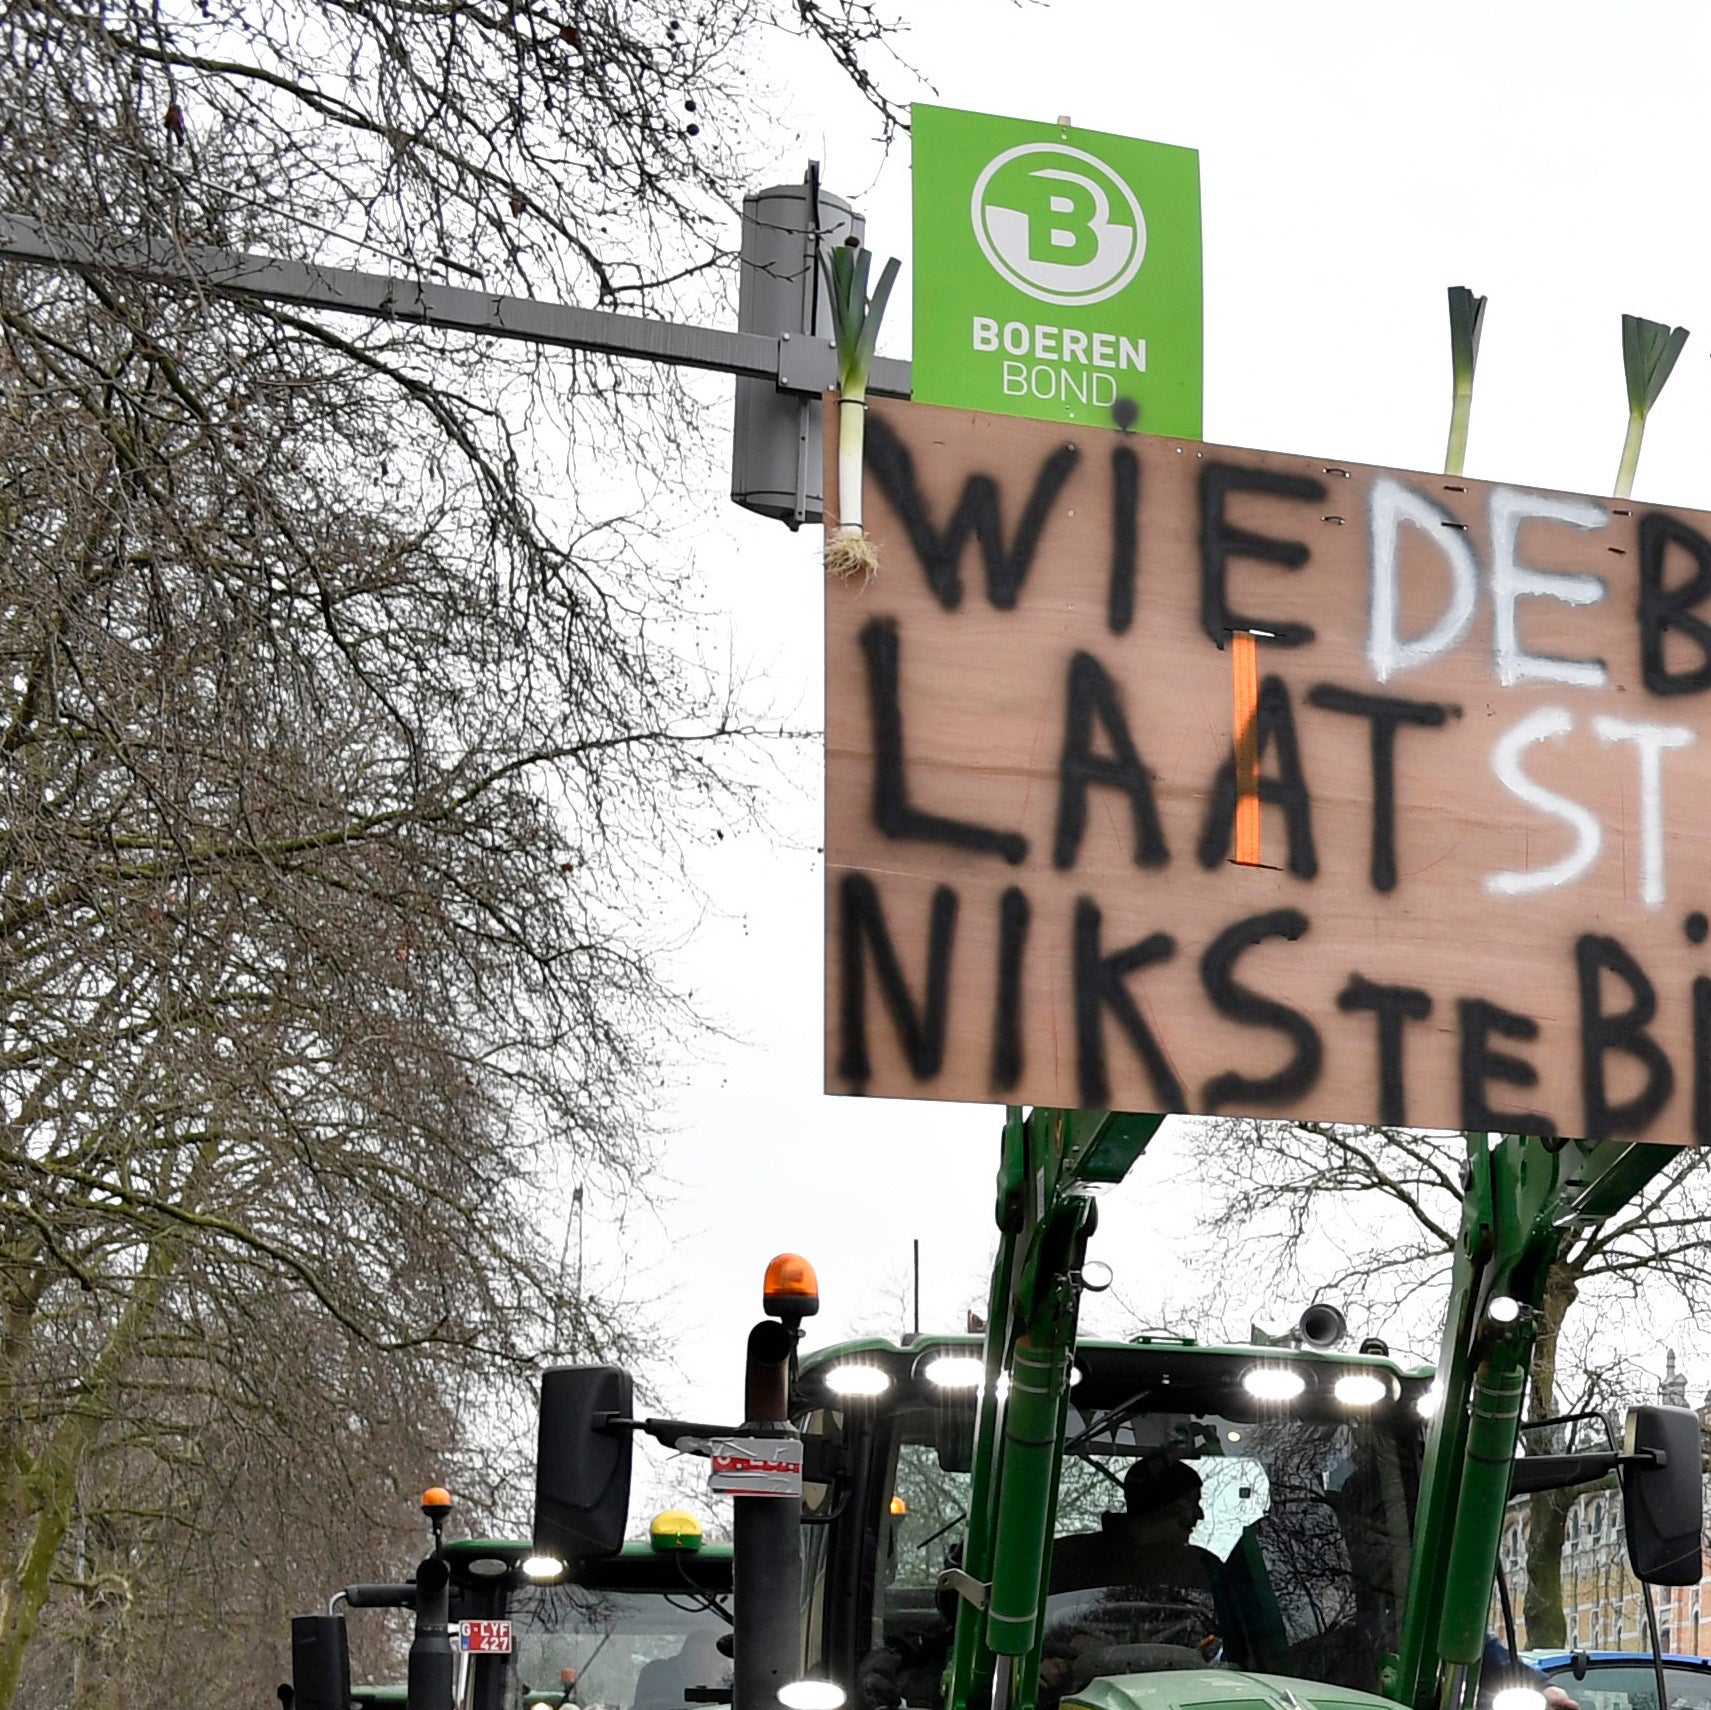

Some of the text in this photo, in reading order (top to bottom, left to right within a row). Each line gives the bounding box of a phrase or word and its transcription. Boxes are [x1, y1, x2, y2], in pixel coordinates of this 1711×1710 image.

[972, 316, 1147, 373] BOEREN
[1003, 360, 1118, 408] BOND
[1367, 476, 1612, 688] DE
[861, 612, 1463, 895] LAAT
[838, 874, 1328, 1112] NIKS
[1337, 971, 1559, 1133] TE
[461, 1622, 509, 1637] G-LYF
[480, 1637, 509, 1650] 427
